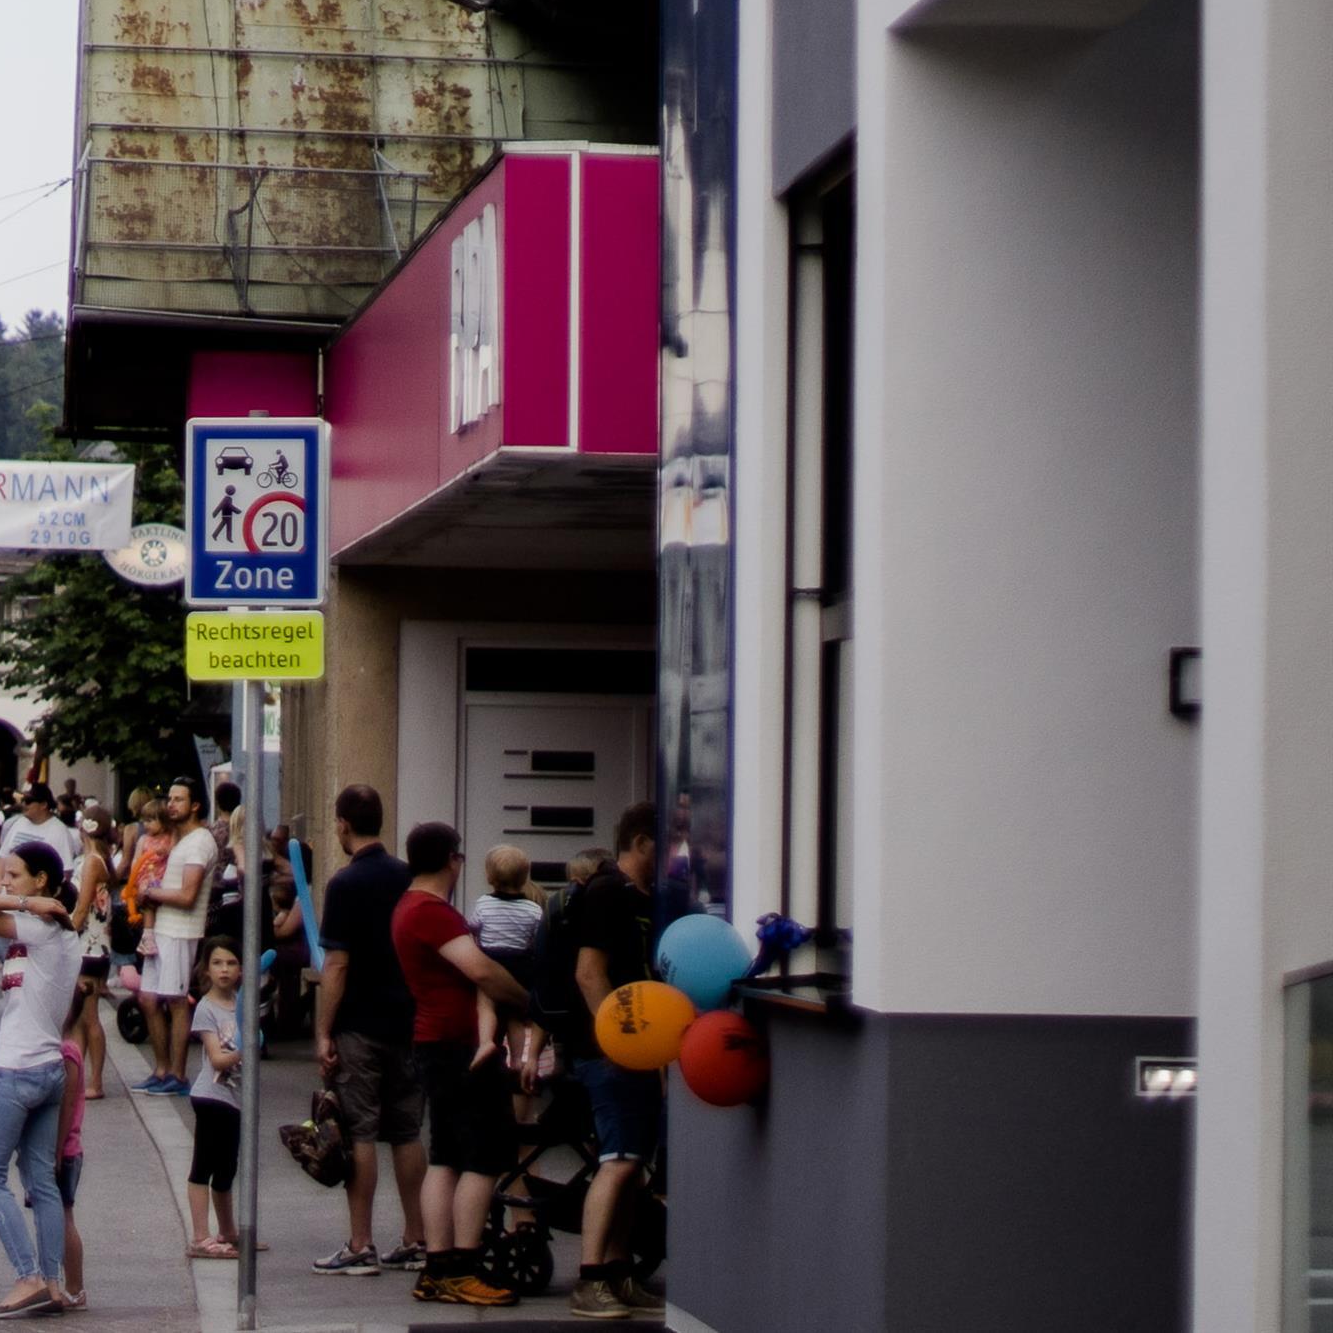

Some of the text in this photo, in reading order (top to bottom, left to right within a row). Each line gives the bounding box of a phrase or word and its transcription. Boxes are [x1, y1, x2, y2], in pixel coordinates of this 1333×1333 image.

[30, 529, 92, 545] 2910G
[261, 511, 298, 547] 20
[214, 560, 295, 590] Zone
[196, 621, 315, 644] Rechtsregel
[209, 651, 301, 669] beachten
